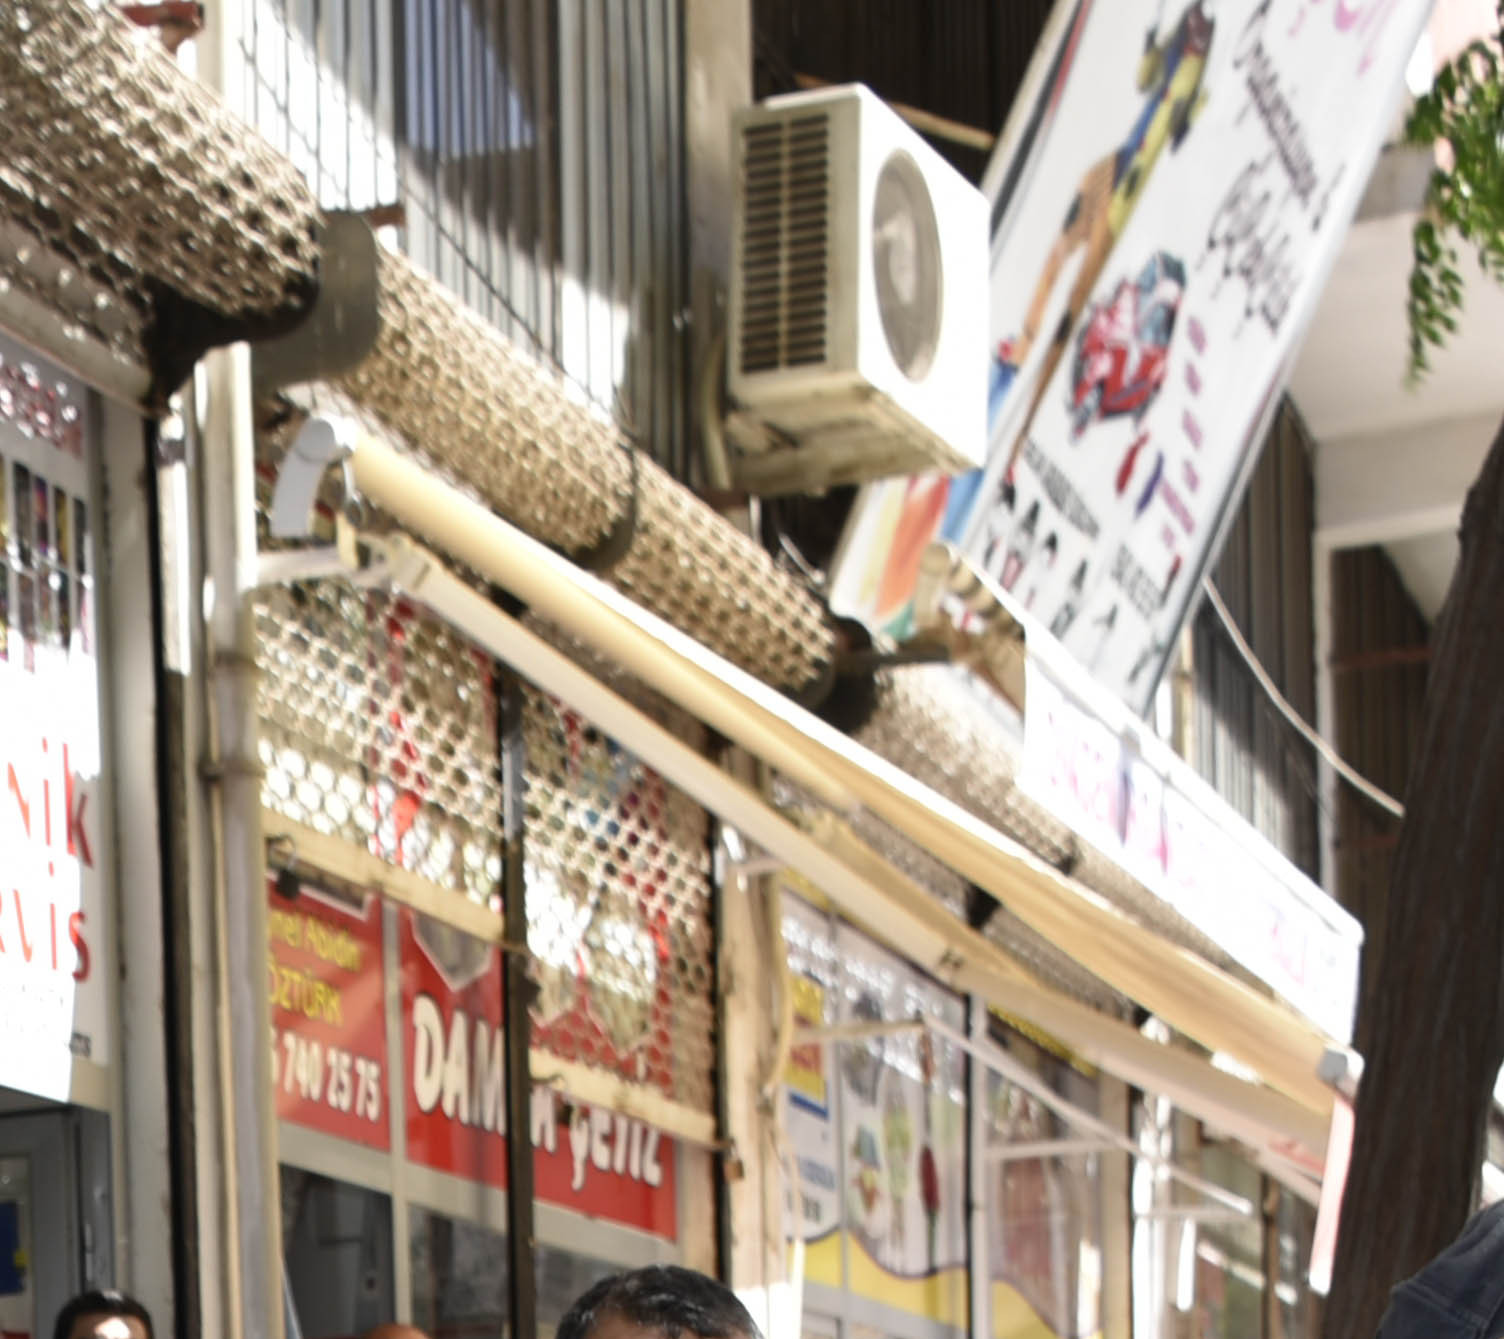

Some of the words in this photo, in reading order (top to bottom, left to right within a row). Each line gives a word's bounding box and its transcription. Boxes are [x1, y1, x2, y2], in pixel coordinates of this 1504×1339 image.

[282, 1031, 322, 1102] 740
[326, 1046, 353, 1114] 25
[354, 1055, 381, 1123] 75
